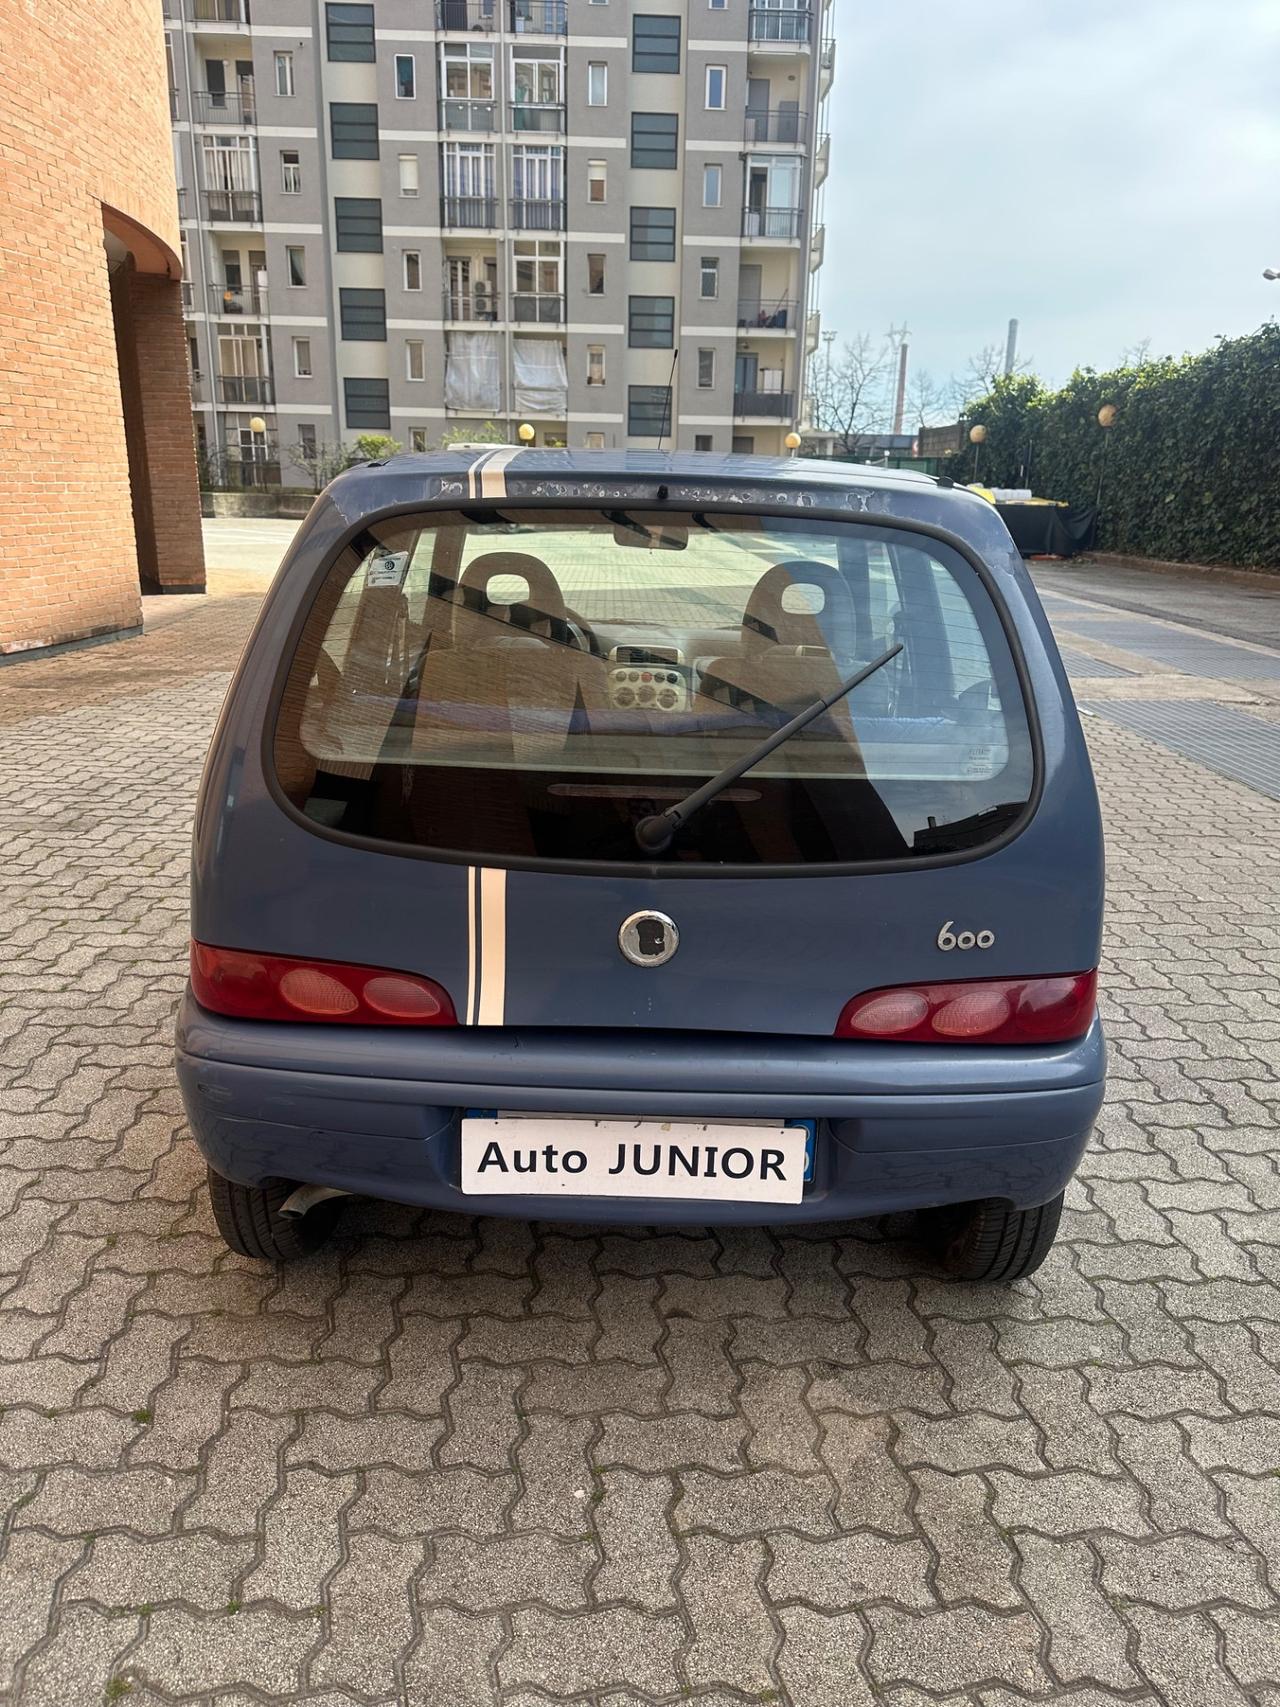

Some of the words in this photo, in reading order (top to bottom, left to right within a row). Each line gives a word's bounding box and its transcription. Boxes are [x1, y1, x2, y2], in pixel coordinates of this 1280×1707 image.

[938, 920, 995, 951] 600
[477, 1142, 588, 1173] Auto
[608, 1143, 787, 1181] JUNIOR
